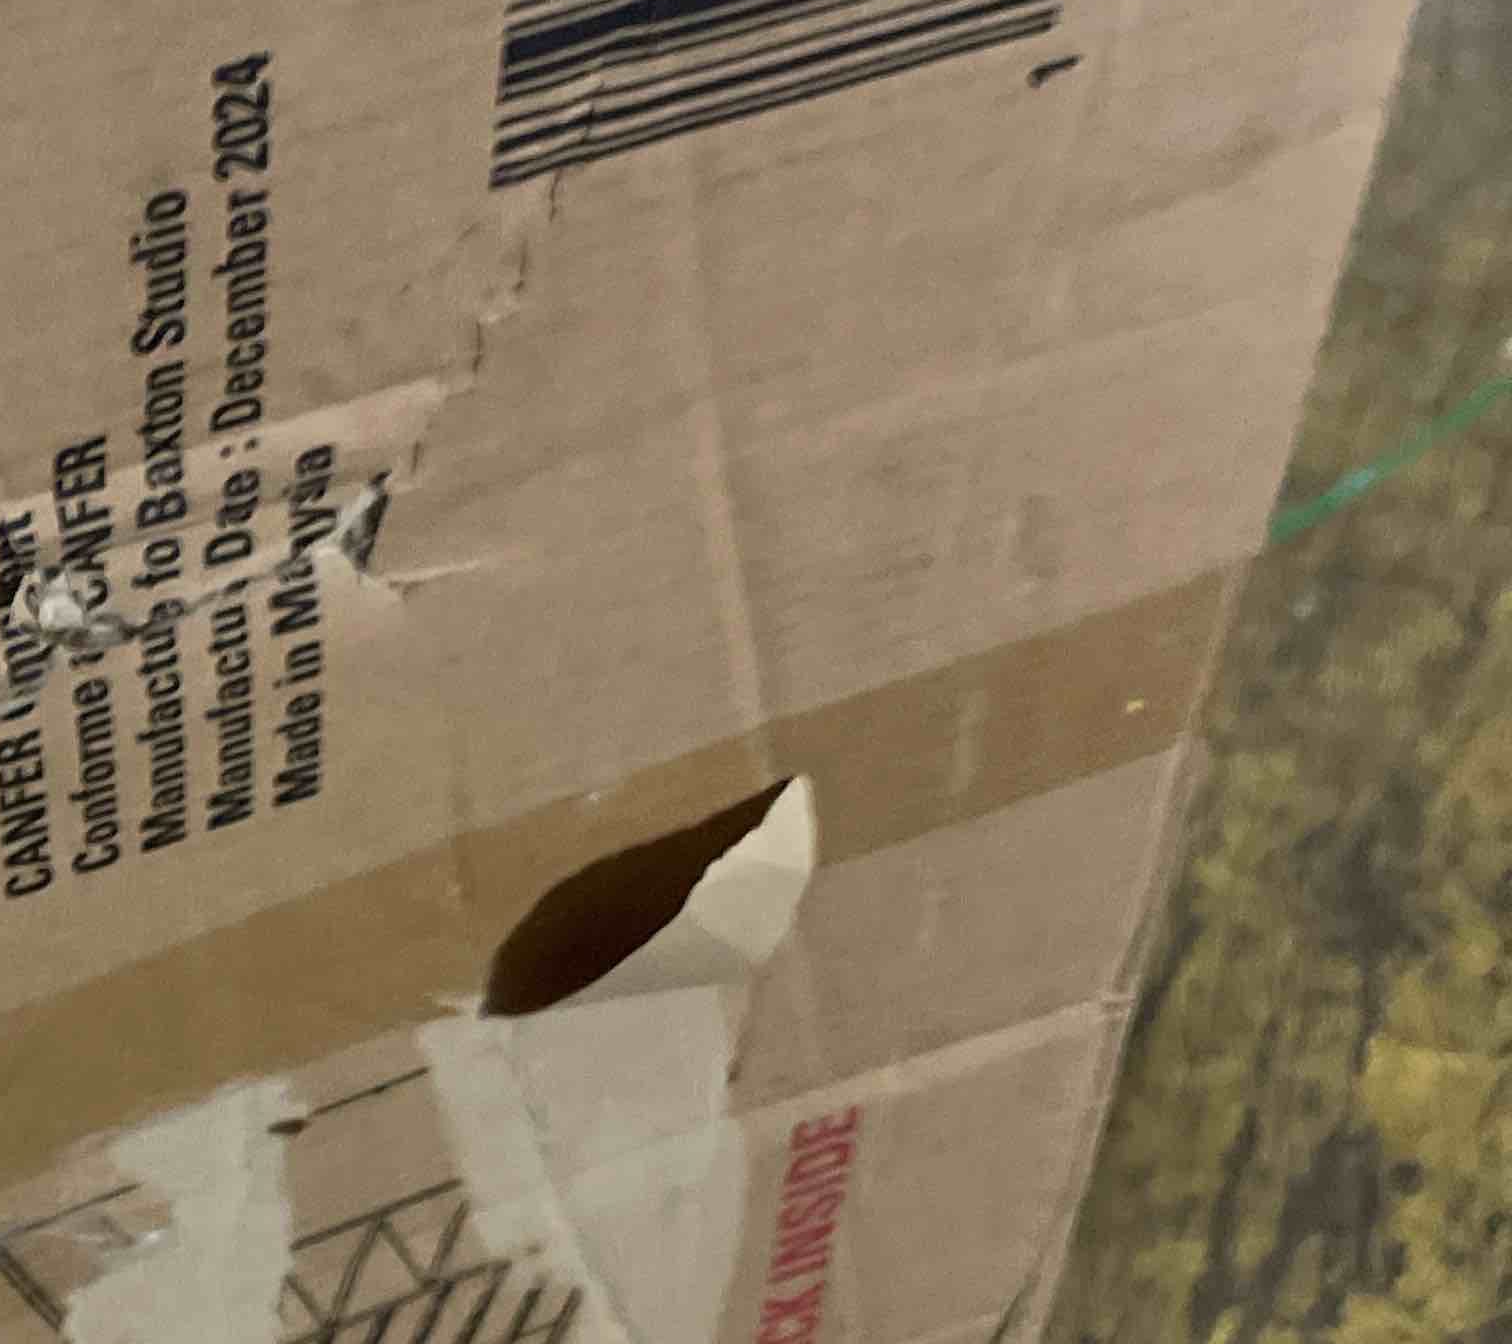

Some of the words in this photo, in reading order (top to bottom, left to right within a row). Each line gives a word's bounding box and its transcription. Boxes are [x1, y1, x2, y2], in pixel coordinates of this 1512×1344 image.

[212, 50, 273, 183] 2024
[1027, 54, 1082, 87] 1
[129, 188, 189, 357] Studio
[209, 188, 269, 435] December
[135, 359, 187, 530] Baxton
[131, 540, 183, 593] fo
[276, 639, 323, 681] in
[67, 679, 121, 876] Conforme
[273, 689, 323, 808] Made
[767, 1104, 860, 1285] INSIDE
